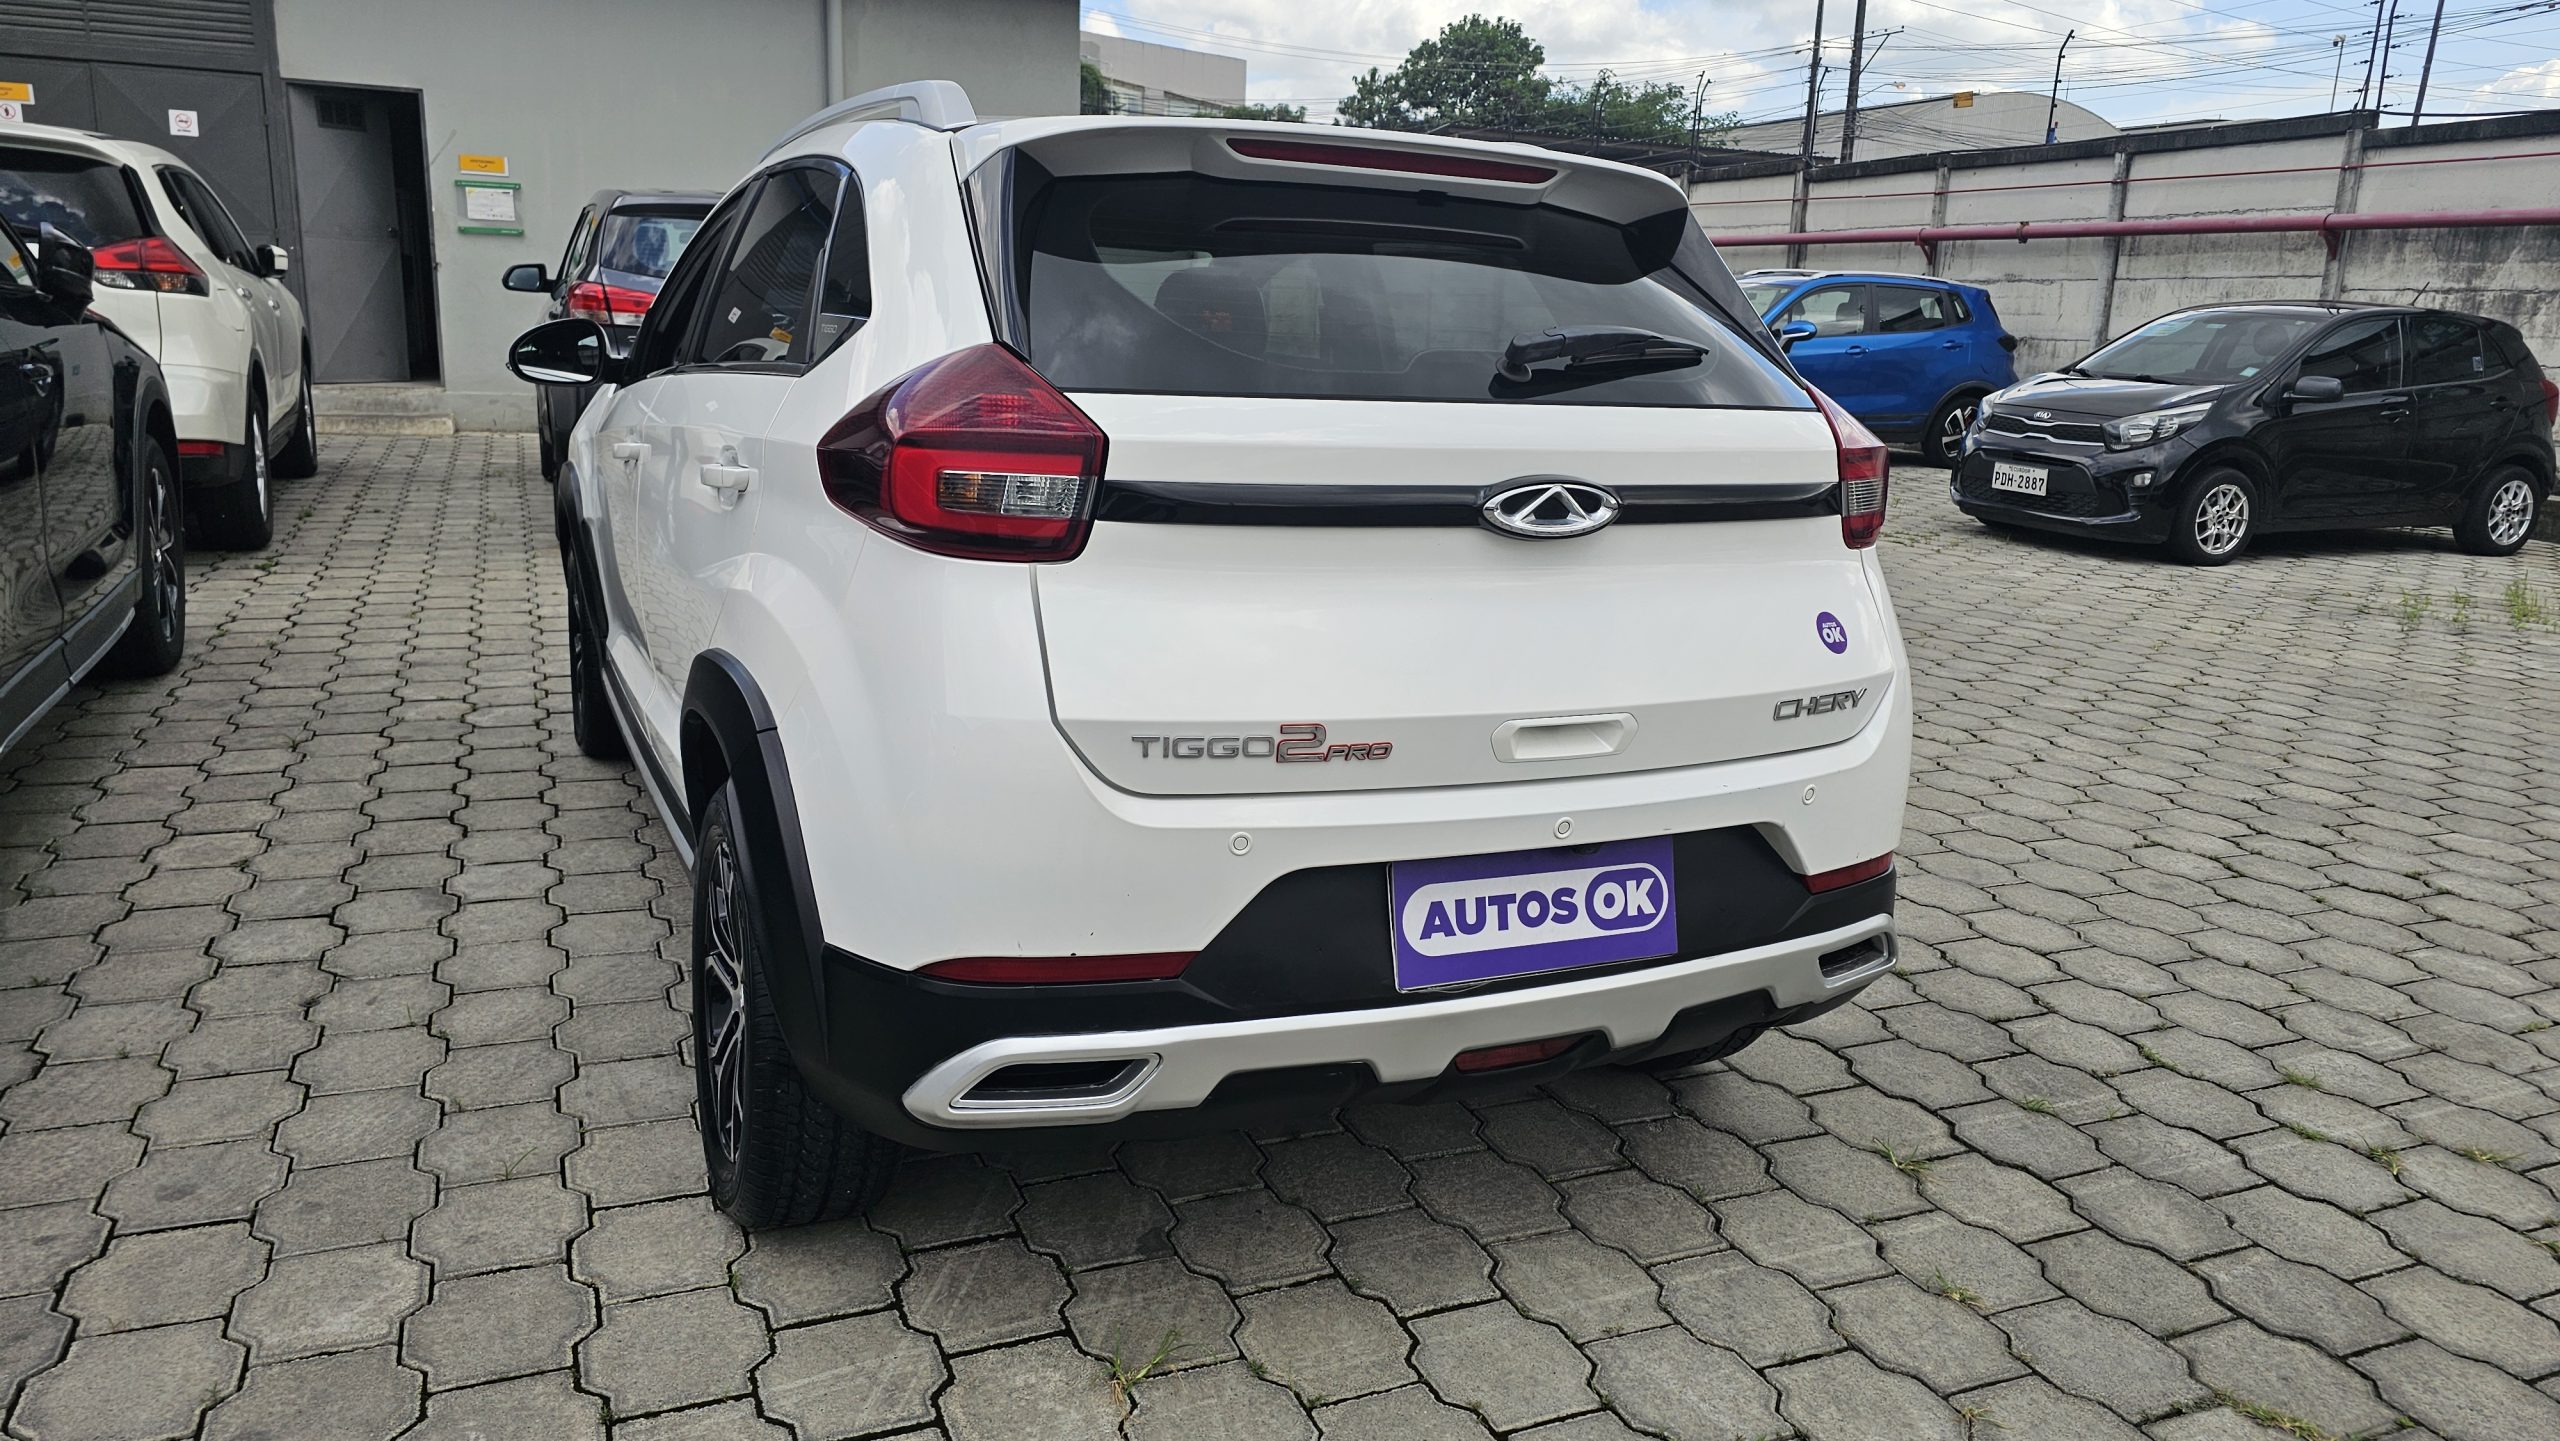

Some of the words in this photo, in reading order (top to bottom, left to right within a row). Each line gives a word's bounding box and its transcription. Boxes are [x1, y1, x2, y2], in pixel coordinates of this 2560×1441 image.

[1994, 471, 2045, 492] PDH-2887
[1822, 626, 1846, 644] OK
[1773, 687, 1868, 721] CHERY
[1131, 734, 1276, 759] TIGGO
[1419, 887, 1579, 941] AUTOS
[1592, 877, 1657, 920] OK
